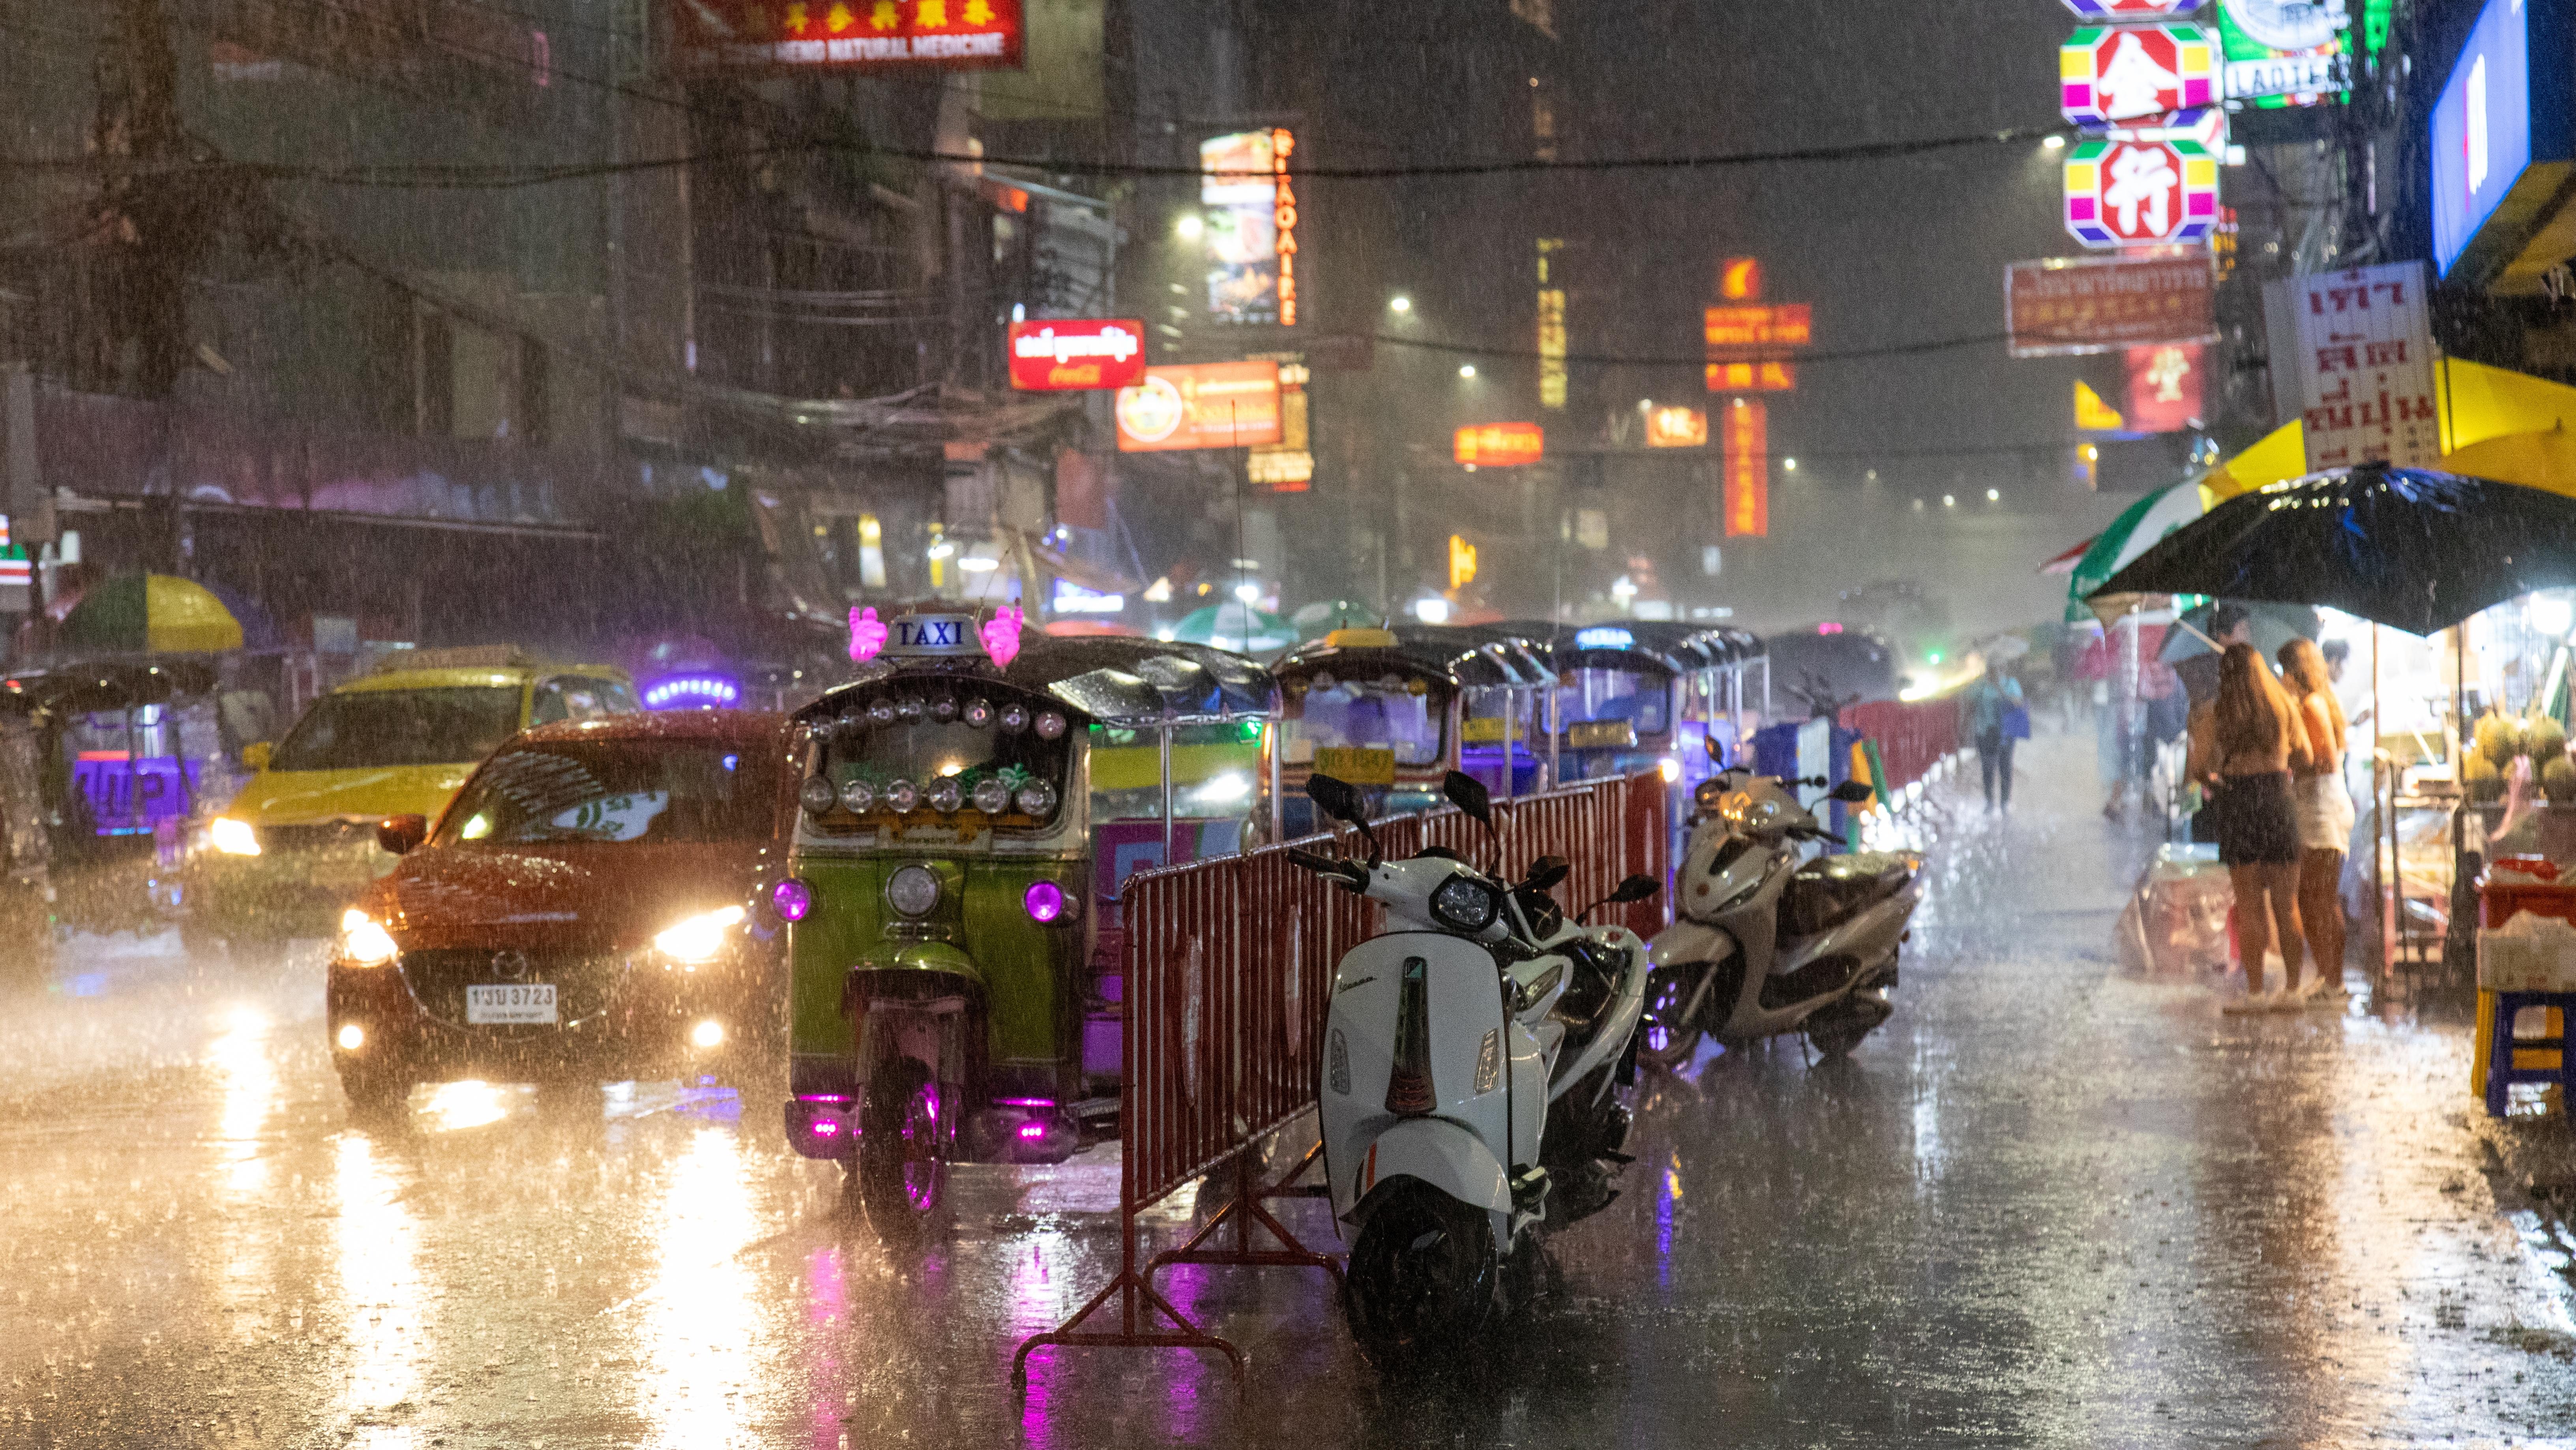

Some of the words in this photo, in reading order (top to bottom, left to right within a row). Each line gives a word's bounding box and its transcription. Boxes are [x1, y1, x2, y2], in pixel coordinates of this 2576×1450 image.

[912, 32, 1004, 58] MEDICINE
[897, 621, 963, 646] TAXI
[511, 987, 553, 1005] 3723
